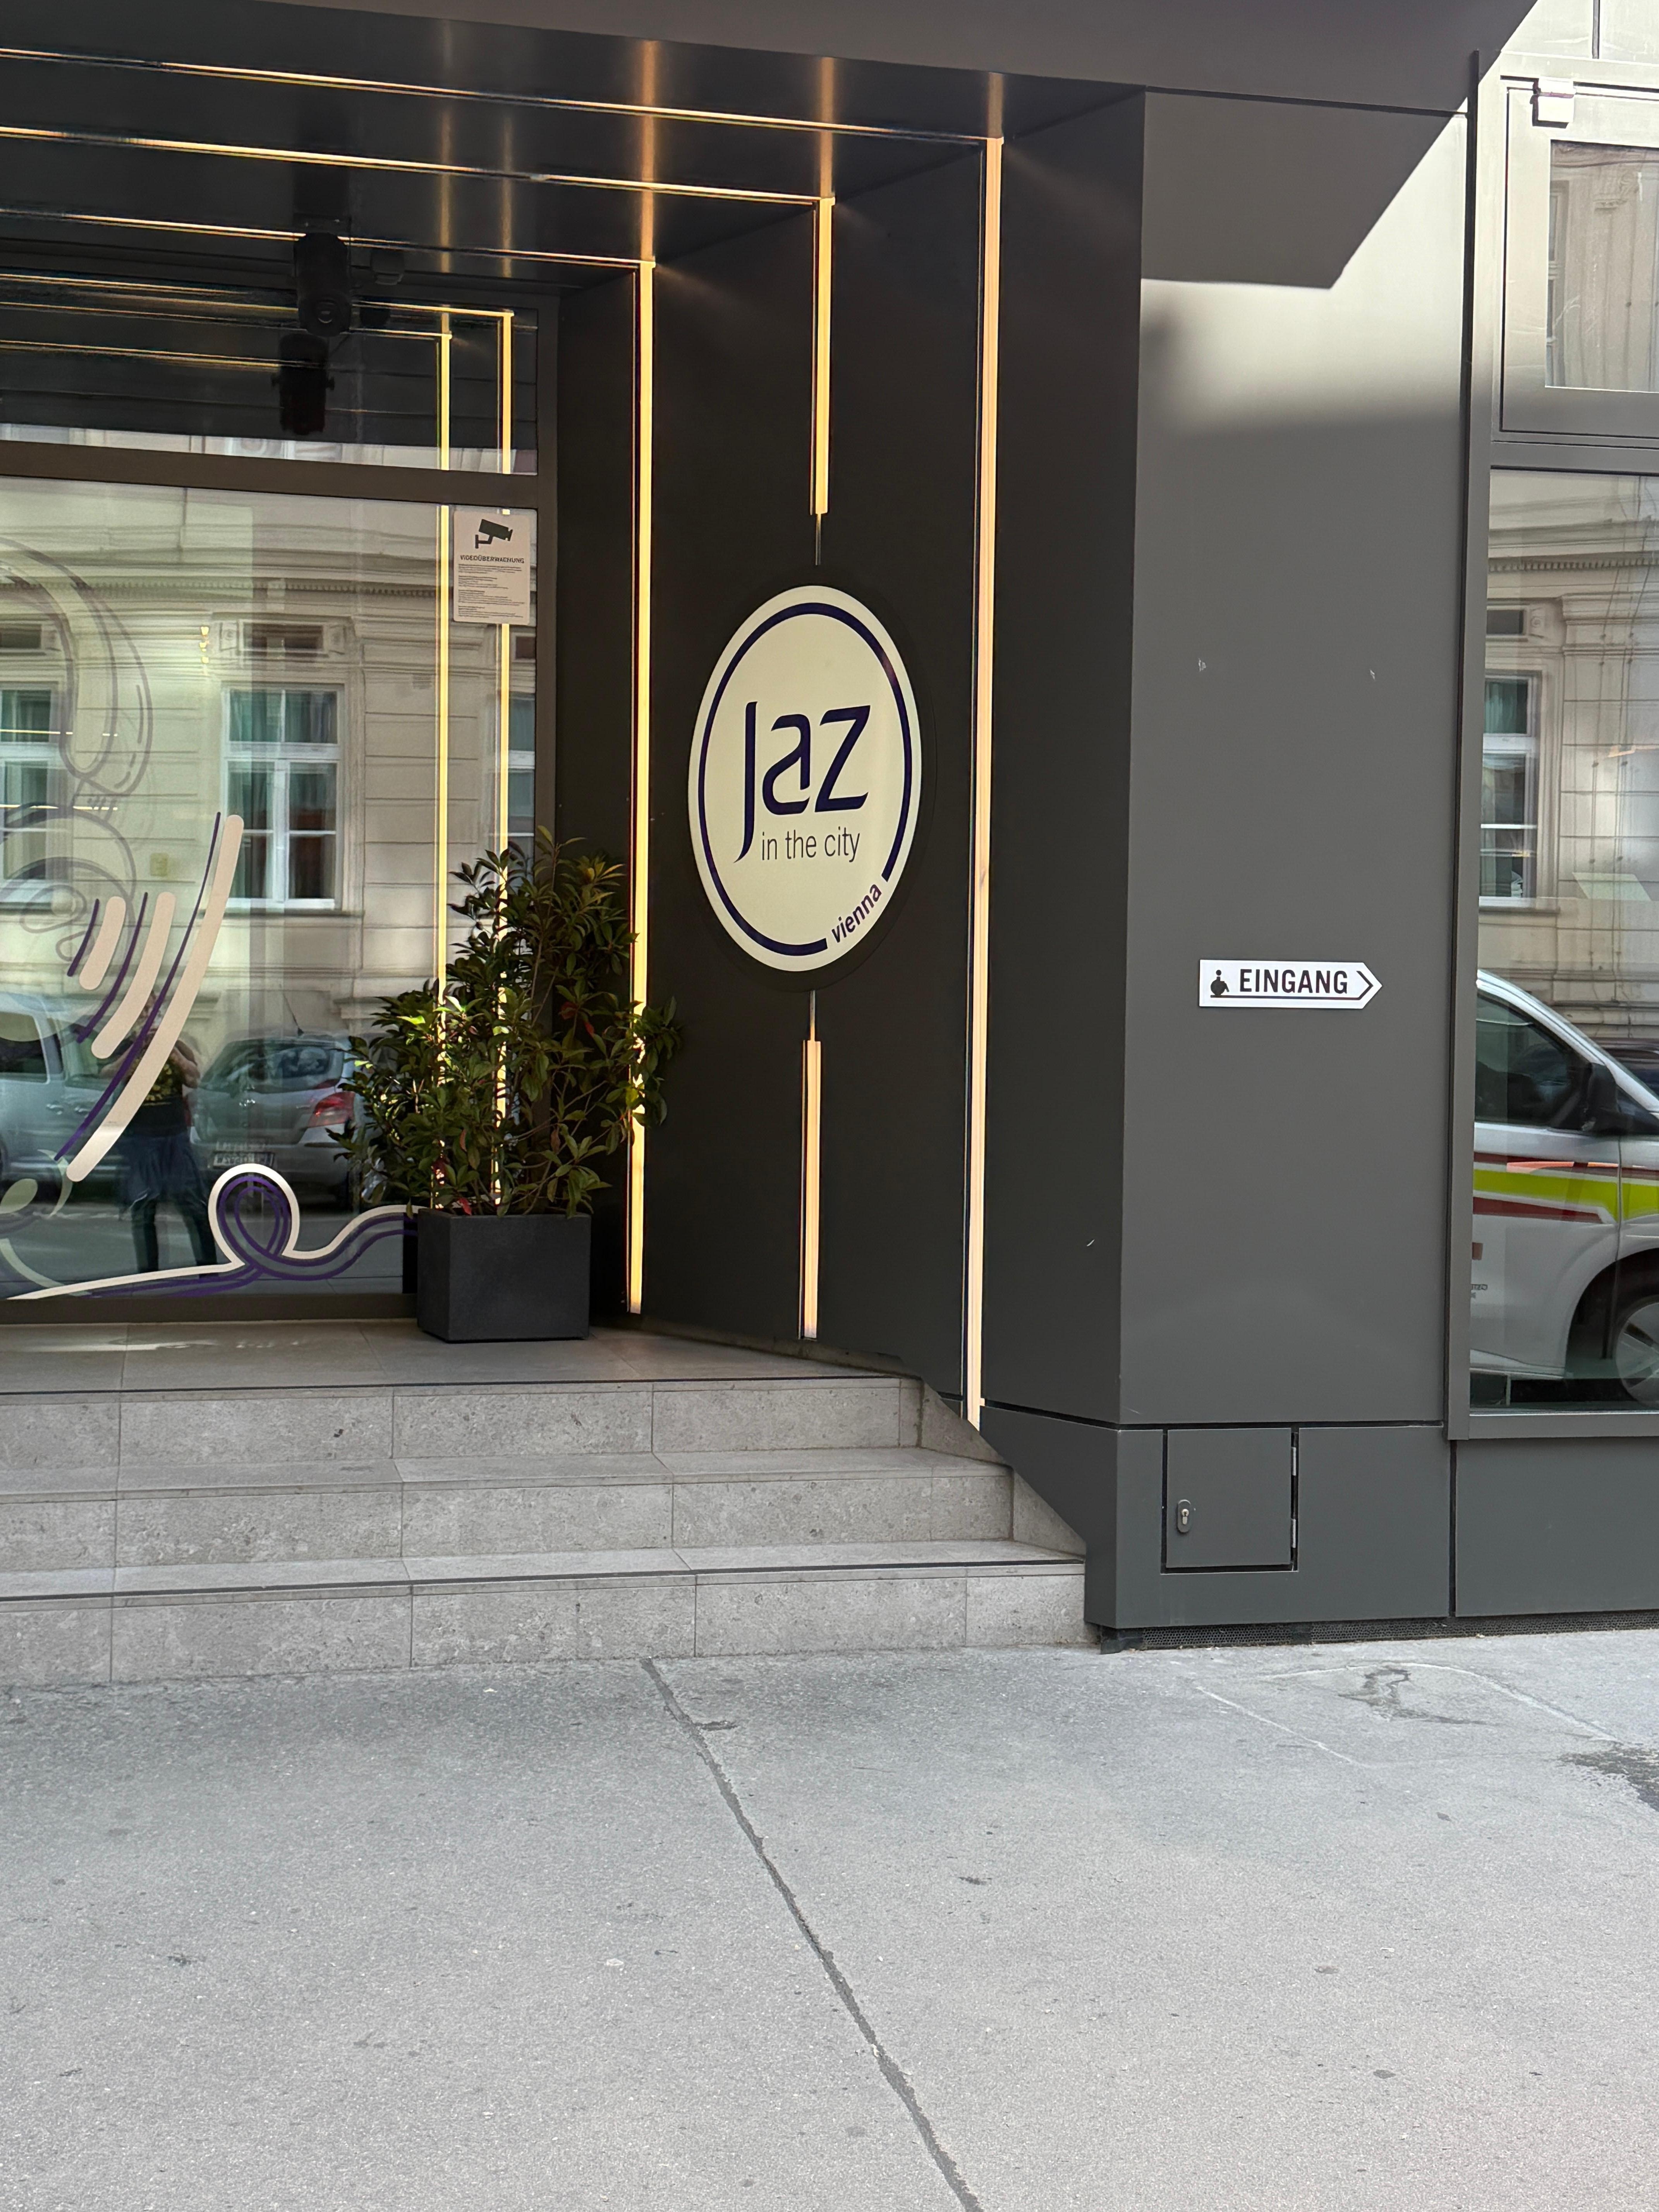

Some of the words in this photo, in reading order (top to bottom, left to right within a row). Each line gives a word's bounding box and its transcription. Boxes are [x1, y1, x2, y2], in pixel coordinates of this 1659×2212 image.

[460, 555, 524, 564] VIDEOÜBERWACHUNG
[734, 701, 871, 863] Jaz
[762, 831, 777, 861] in
[785, 830, 816, 859] the
[824, 826, 860, 863] city
[831, 884, 882, 943] vienna
[1239, 969, 1348, 994] EINGANG
